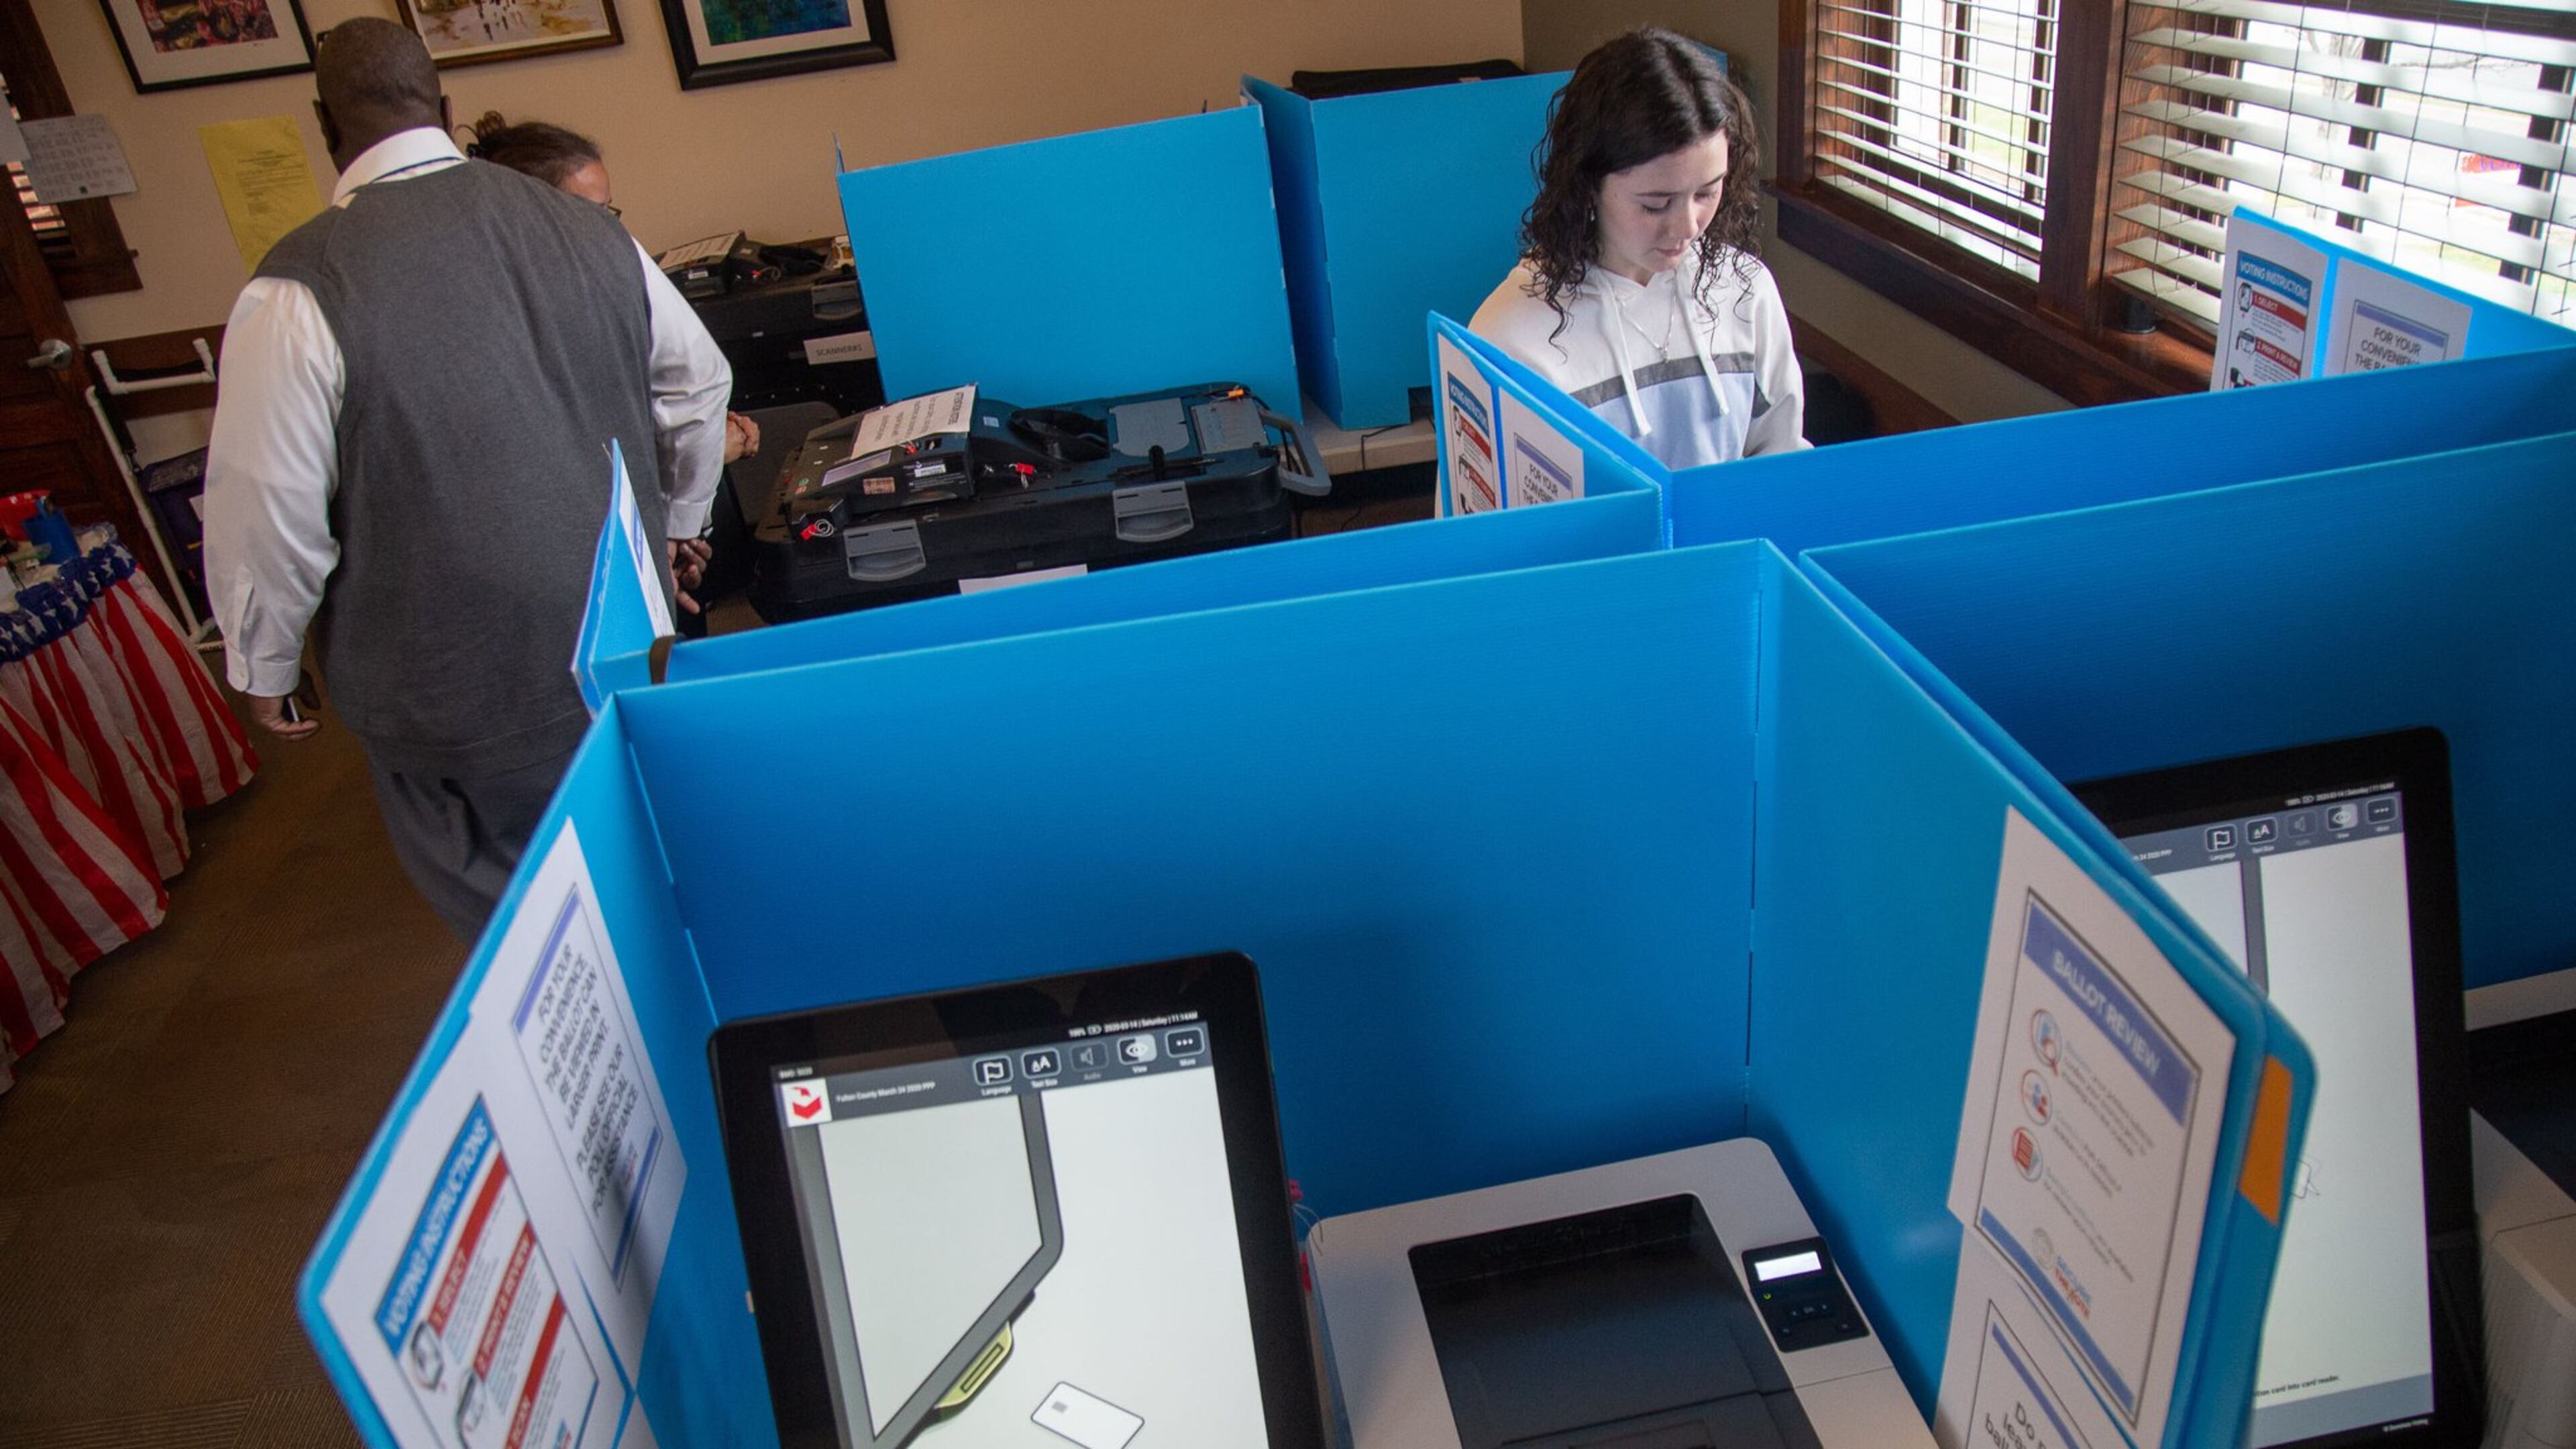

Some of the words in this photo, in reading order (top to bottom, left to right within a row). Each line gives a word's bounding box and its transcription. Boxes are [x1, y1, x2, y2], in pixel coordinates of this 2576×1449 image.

[2241, 260, 2266, 280] VOTING
[2266, 270, 2308, 301] INSTRUCTIONS
[2373, 327, 2394, 344] FOR
[2395, 335, 2421, 357] YOUR
[539, 985, 555, 1024] FOR
[552, 944, 572, 990] YOUR
[541, 953, 589, 1063] CONVENIENCE
[2053, 949, 2106, 1015] BALLOT
[2106, 1004, 2161, 1076] REVIEW
[545, 1055, 561, 1093] THE
[559, 998, 583, 1061] BALLOT
[581, 966, 597, 1003] CAN
[559, 1075, 571, 1104] BE
[568, 1018, 593, 1078] VIEWED
[590, 998, 600, 1024] IN
[564, 1063, 592, 1130] LARGER
[577, 1104, 600, 1172] PLEASE
[598, 1076, 610, 1112] SEE
[608, 1044, 624, 1081] OUR
[857, 1091, 877, 1100] County
[877, 1088, 898, 1097] March
[981, 1085, 1012, 1095] Language
[588, 1140, 604, 1185] POLL
[602, 1074, 629, 1142] OFFICIAL
[384, 1248, 428, 1337] VOTING
[420, 1118, 488, 1258] INSTRUCTIONS
[593, 1177, 606, 1218] FOR
[2015, 1401, 2035, 1441] Do
[2271, 1385, 2286, 1395] card
[2302, 1379, 2317, 1388] card
